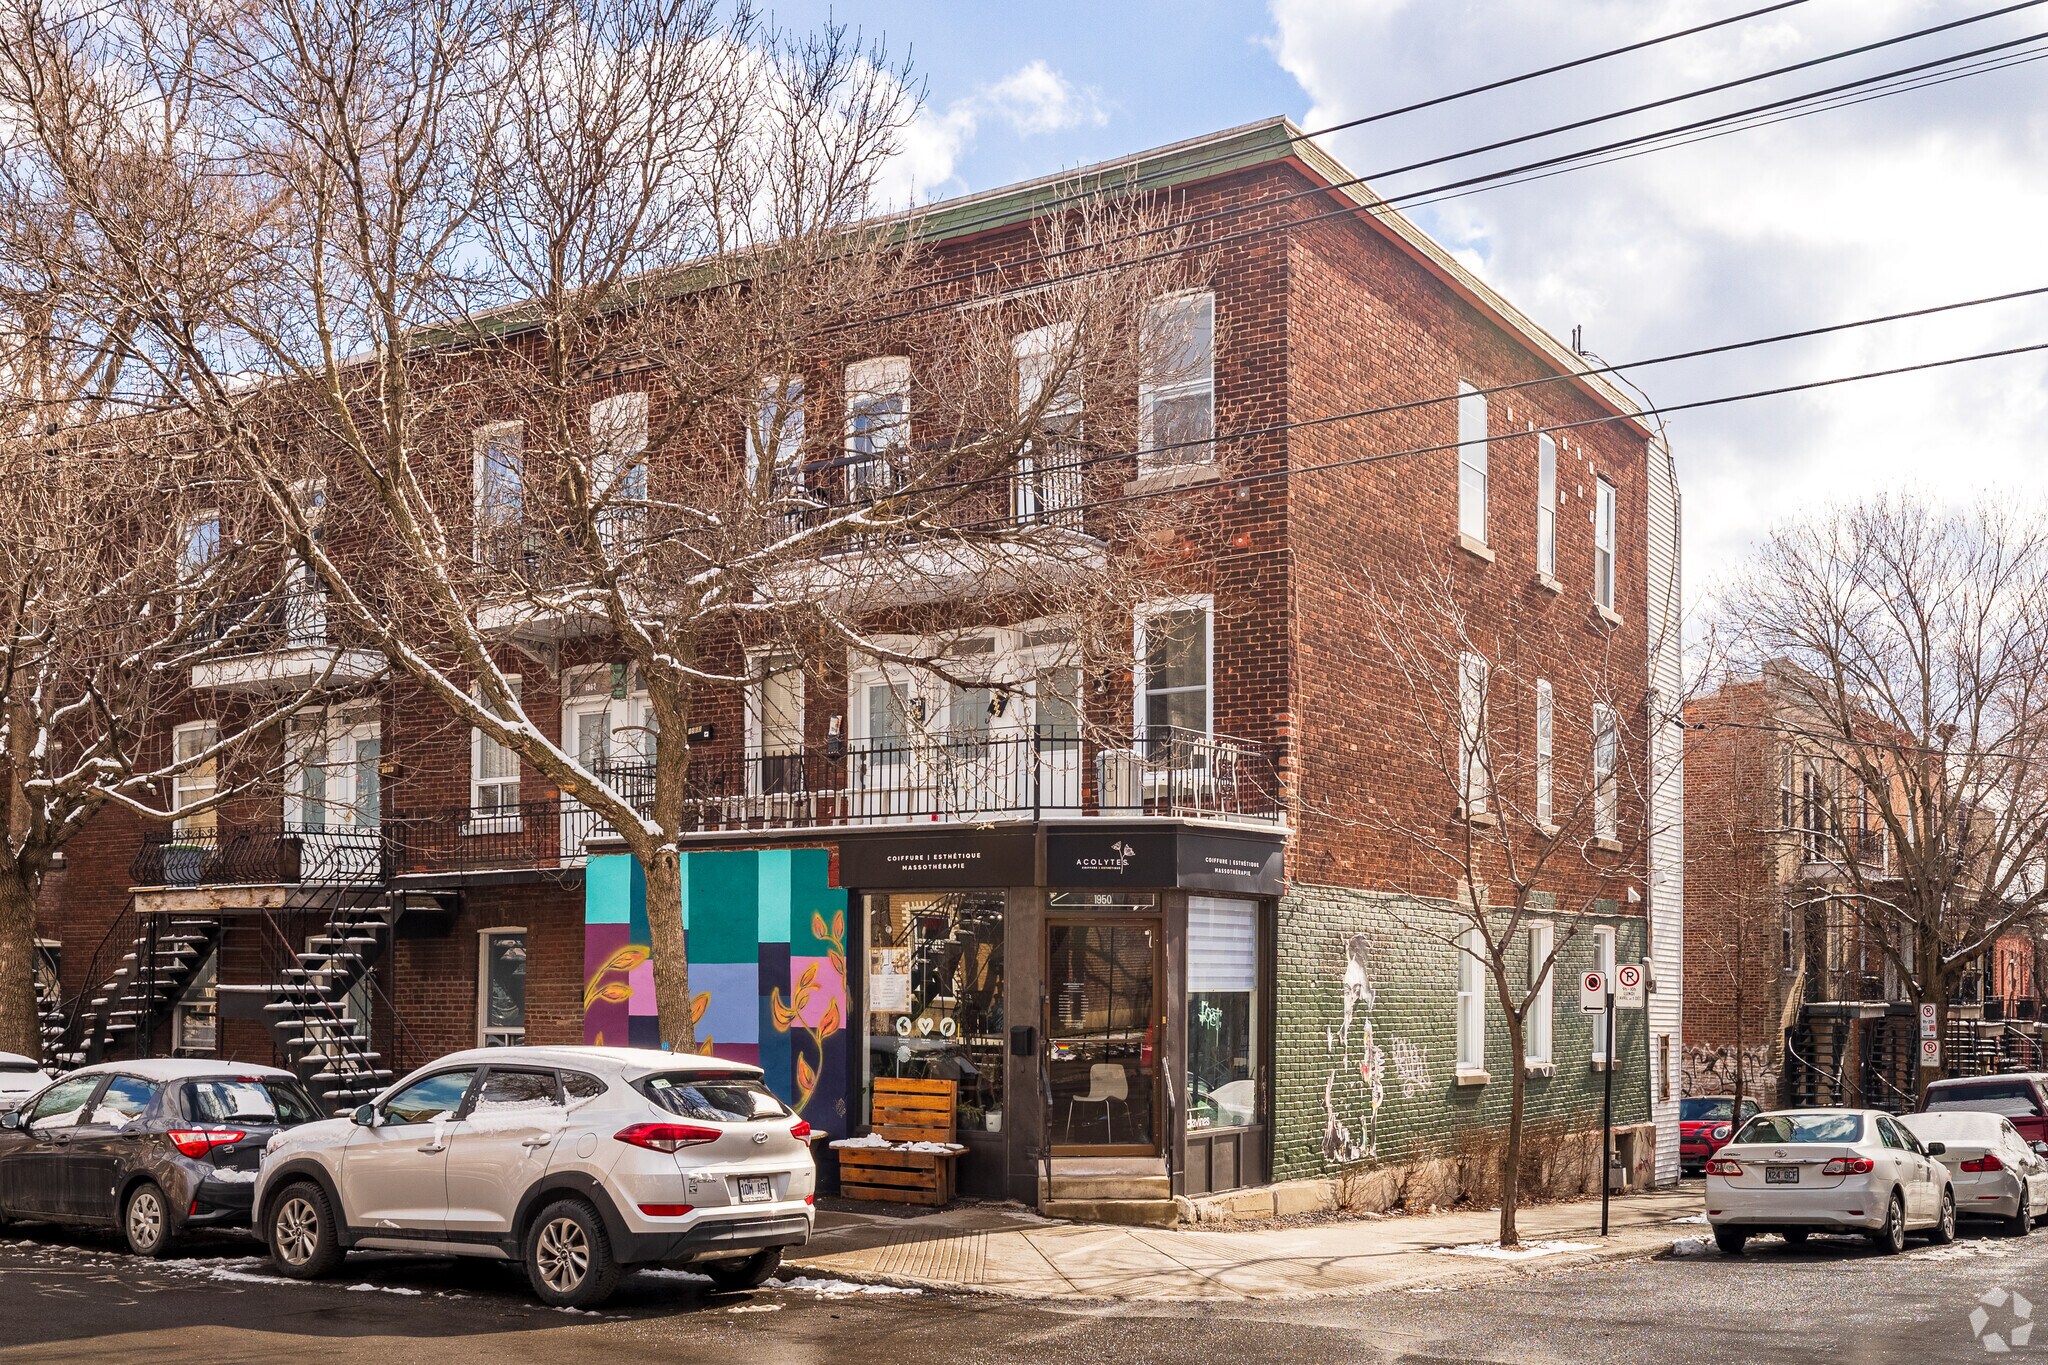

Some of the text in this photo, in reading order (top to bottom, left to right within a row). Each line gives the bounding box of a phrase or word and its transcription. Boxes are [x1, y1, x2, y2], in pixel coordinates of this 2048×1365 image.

[887, 854, 924, 862] COIFFURE
[933, 852, 981, 860] ESTHÉTIQUE
[1076, 858, 1128, 866] ACOLYTES
[902, 862, 965, 871] MASSOTHÉRAPIE
[1205, 857, 1228, 865] COIFFURE
[1232, 859, 1259, 868] ESTHÉTIQUE
[1094, 894, 1112, 904] 1950
